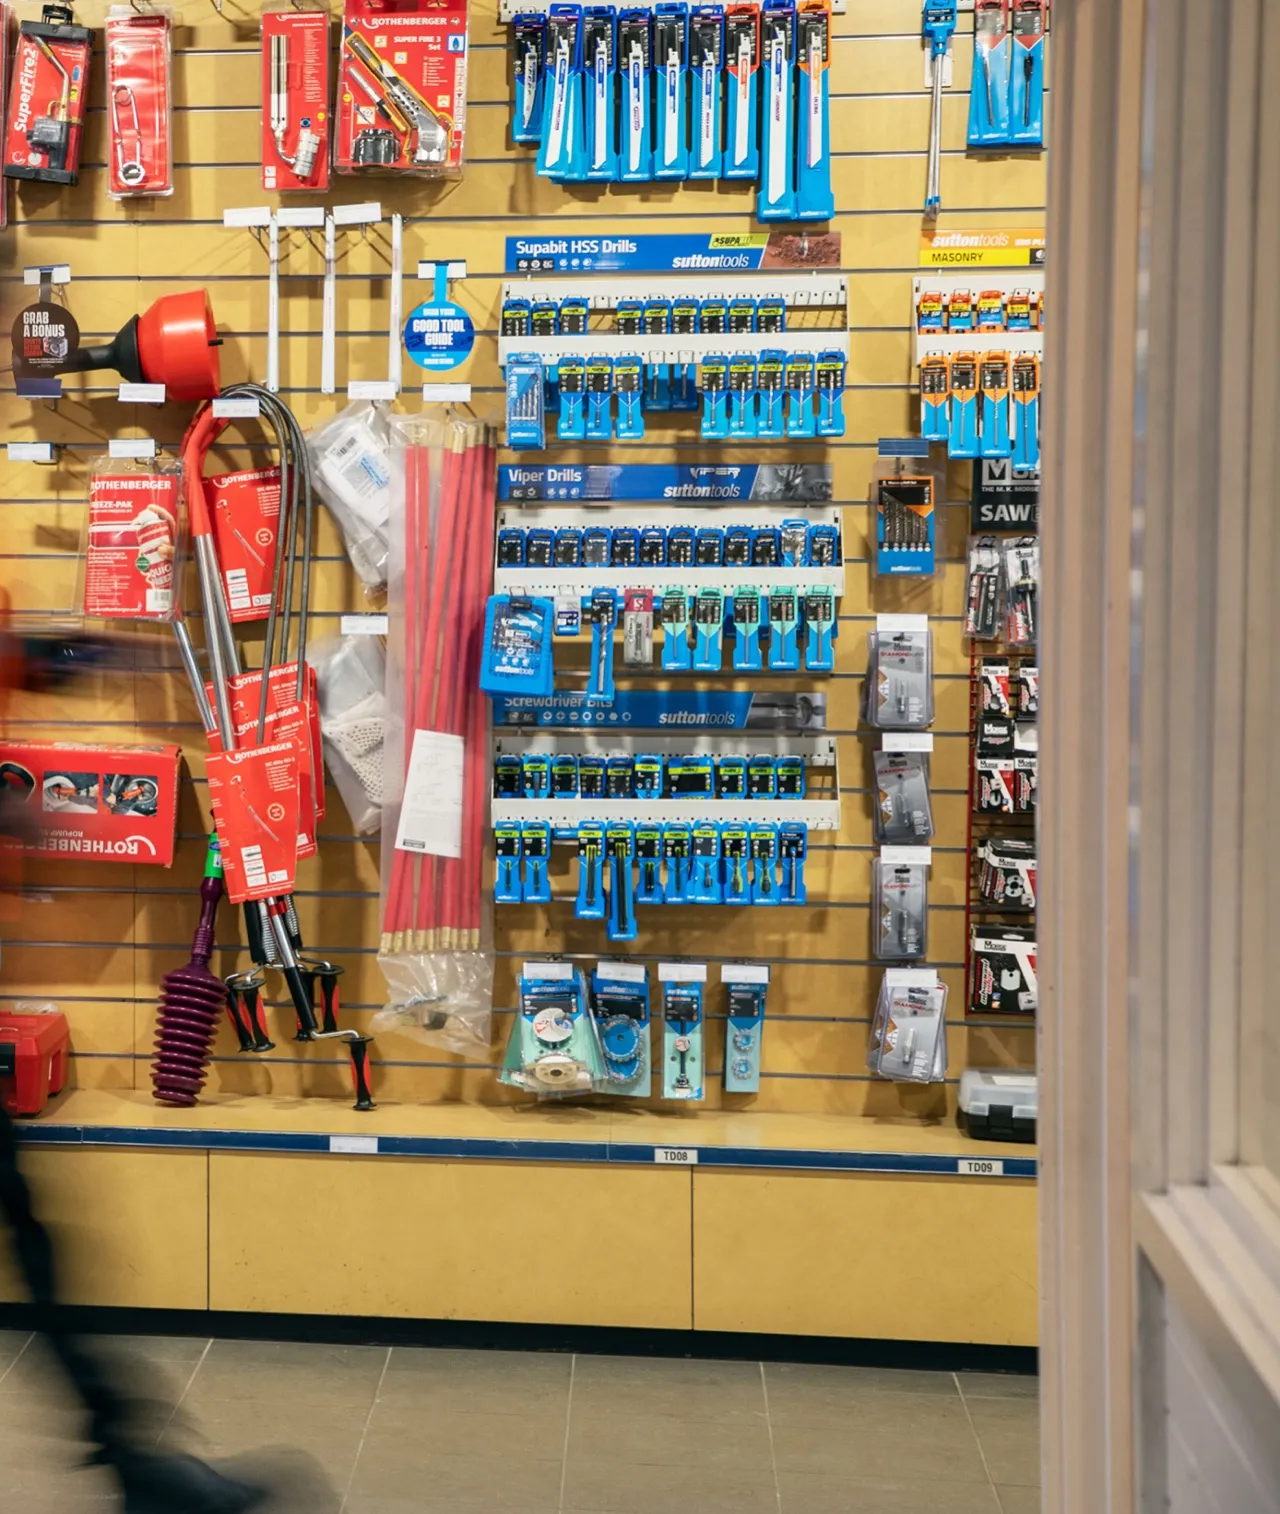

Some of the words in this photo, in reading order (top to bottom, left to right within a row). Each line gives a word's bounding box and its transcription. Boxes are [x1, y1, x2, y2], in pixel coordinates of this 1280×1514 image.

[370, 17, 447, 27] ROTHENBERGER
[428, 43, 442, 51] Set
[14, 41, 38, 133] SuperFire2
[516, 240, 568, 255] Supabit
[571, 240, 599, 253] HSS
[602, 239, 637, 253] Drills
[931, 233, 1009, 248] suttontools
[672, 254, 750, 269] suttontools
[931, 252, 984, 262] MASONRY
[23, 311, 50, 325] GRAB
[23, 325, 31, 338] A
[31, 324, 65, 338] BONUS
[413, 319, 440, 333] GOOD
[441, 319, 466, 332] TOOL
[425, 333, 454, 346] GUIDE
[221, 468, 282, 485] ROTHENBERGE
[508, 468, 544, 483] Viper
[547, 468, 582, 482] Drills
[690, 467, 741, 479] VIPER
[663, 483, 741, 498] suttontools
[92, 501, 133, 509] EEZE-PAK
[980, 503, 1032, 522] SAW
[237, 705, 300, 733] ROTHNBERGER
[658, 711, 735, 726] suttontools
[234, 741, 293, 761] ROTHENBERGER
[663, 1150, 688, 1162] TD08
[967, 1162, 993, 1173] TD09
